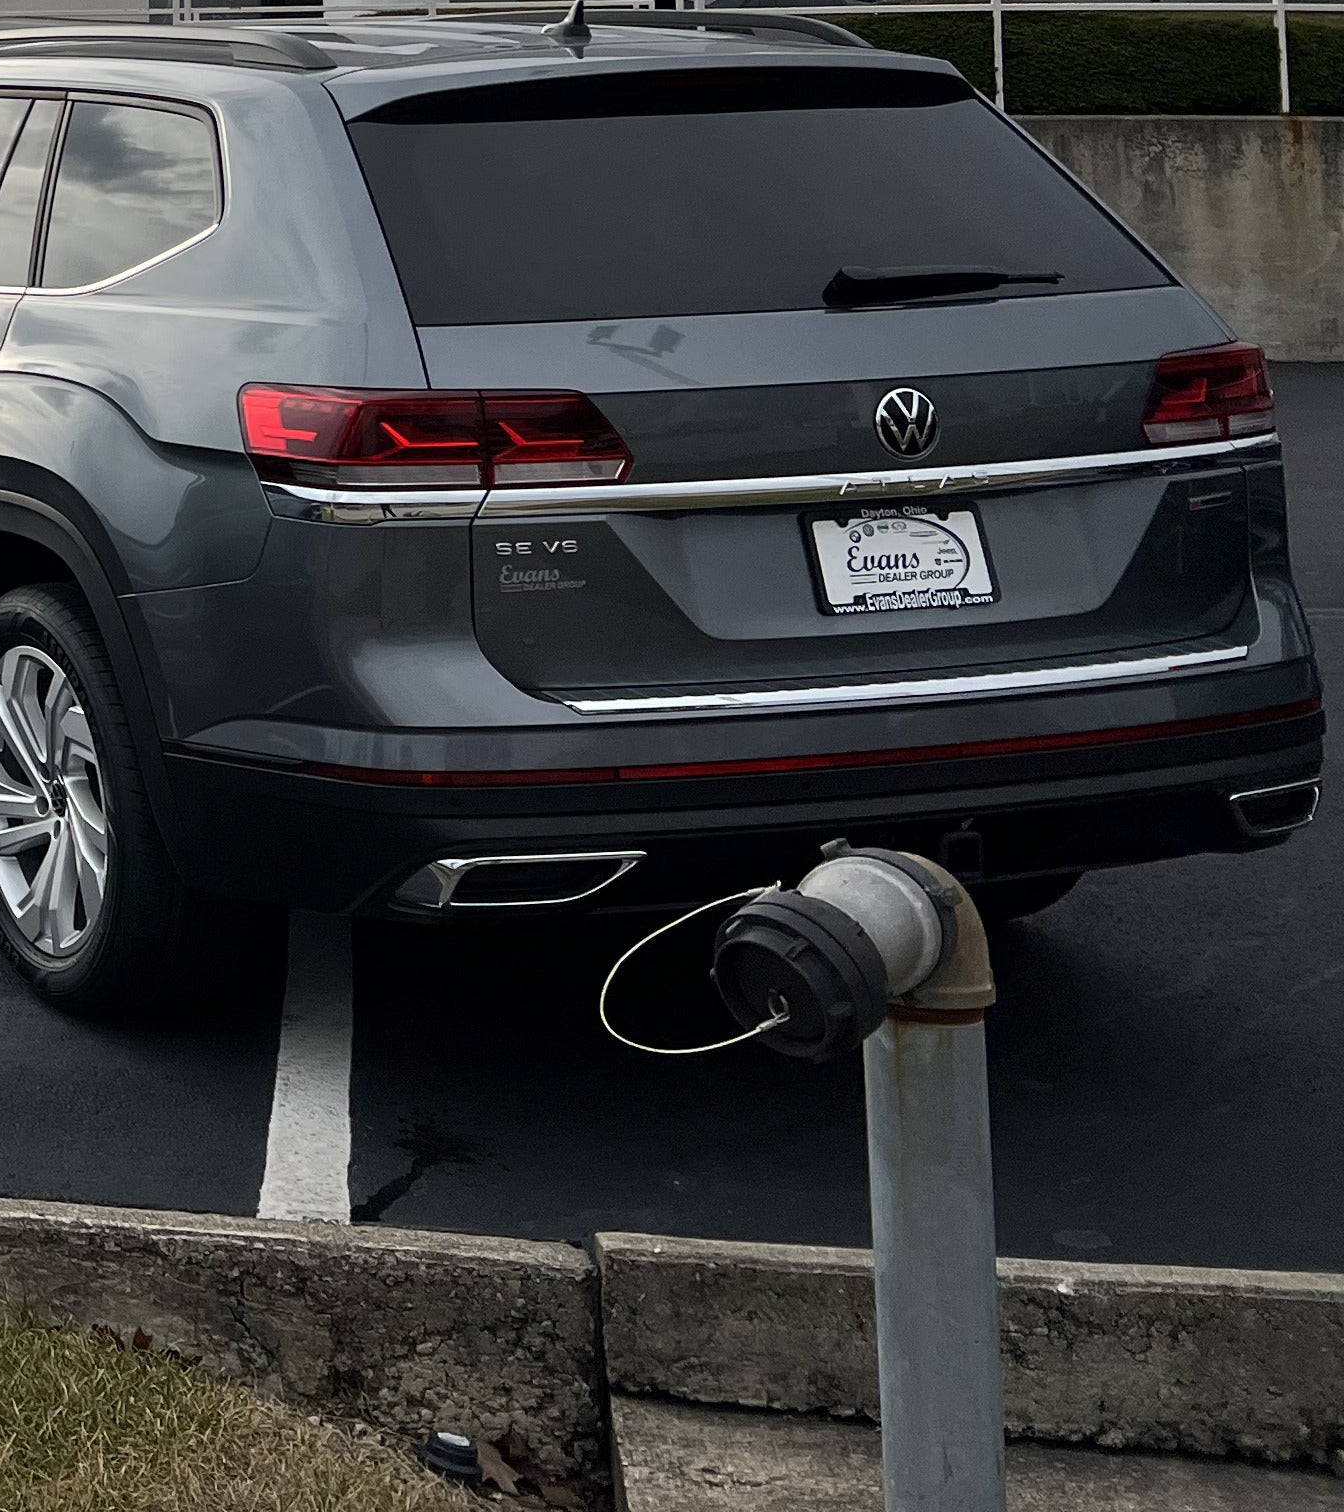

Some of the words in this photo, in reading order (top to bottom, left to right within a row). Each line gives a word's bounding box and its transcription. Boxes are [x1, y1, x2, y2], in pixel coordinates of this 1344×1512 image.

[861, 508, 898, 519] Dayton,
[902, 505, 928, 516] Ohio
[495, 542, 533, 556] SE
[846, 545, 921, 573] Evans
[499, 564, 561, 584] Evans
[878, 572, 918, 583] DEALER
[919, 568, 955, 580] GROUP
[833, 589, 994, 614] www.EvansDealerGroup.com
